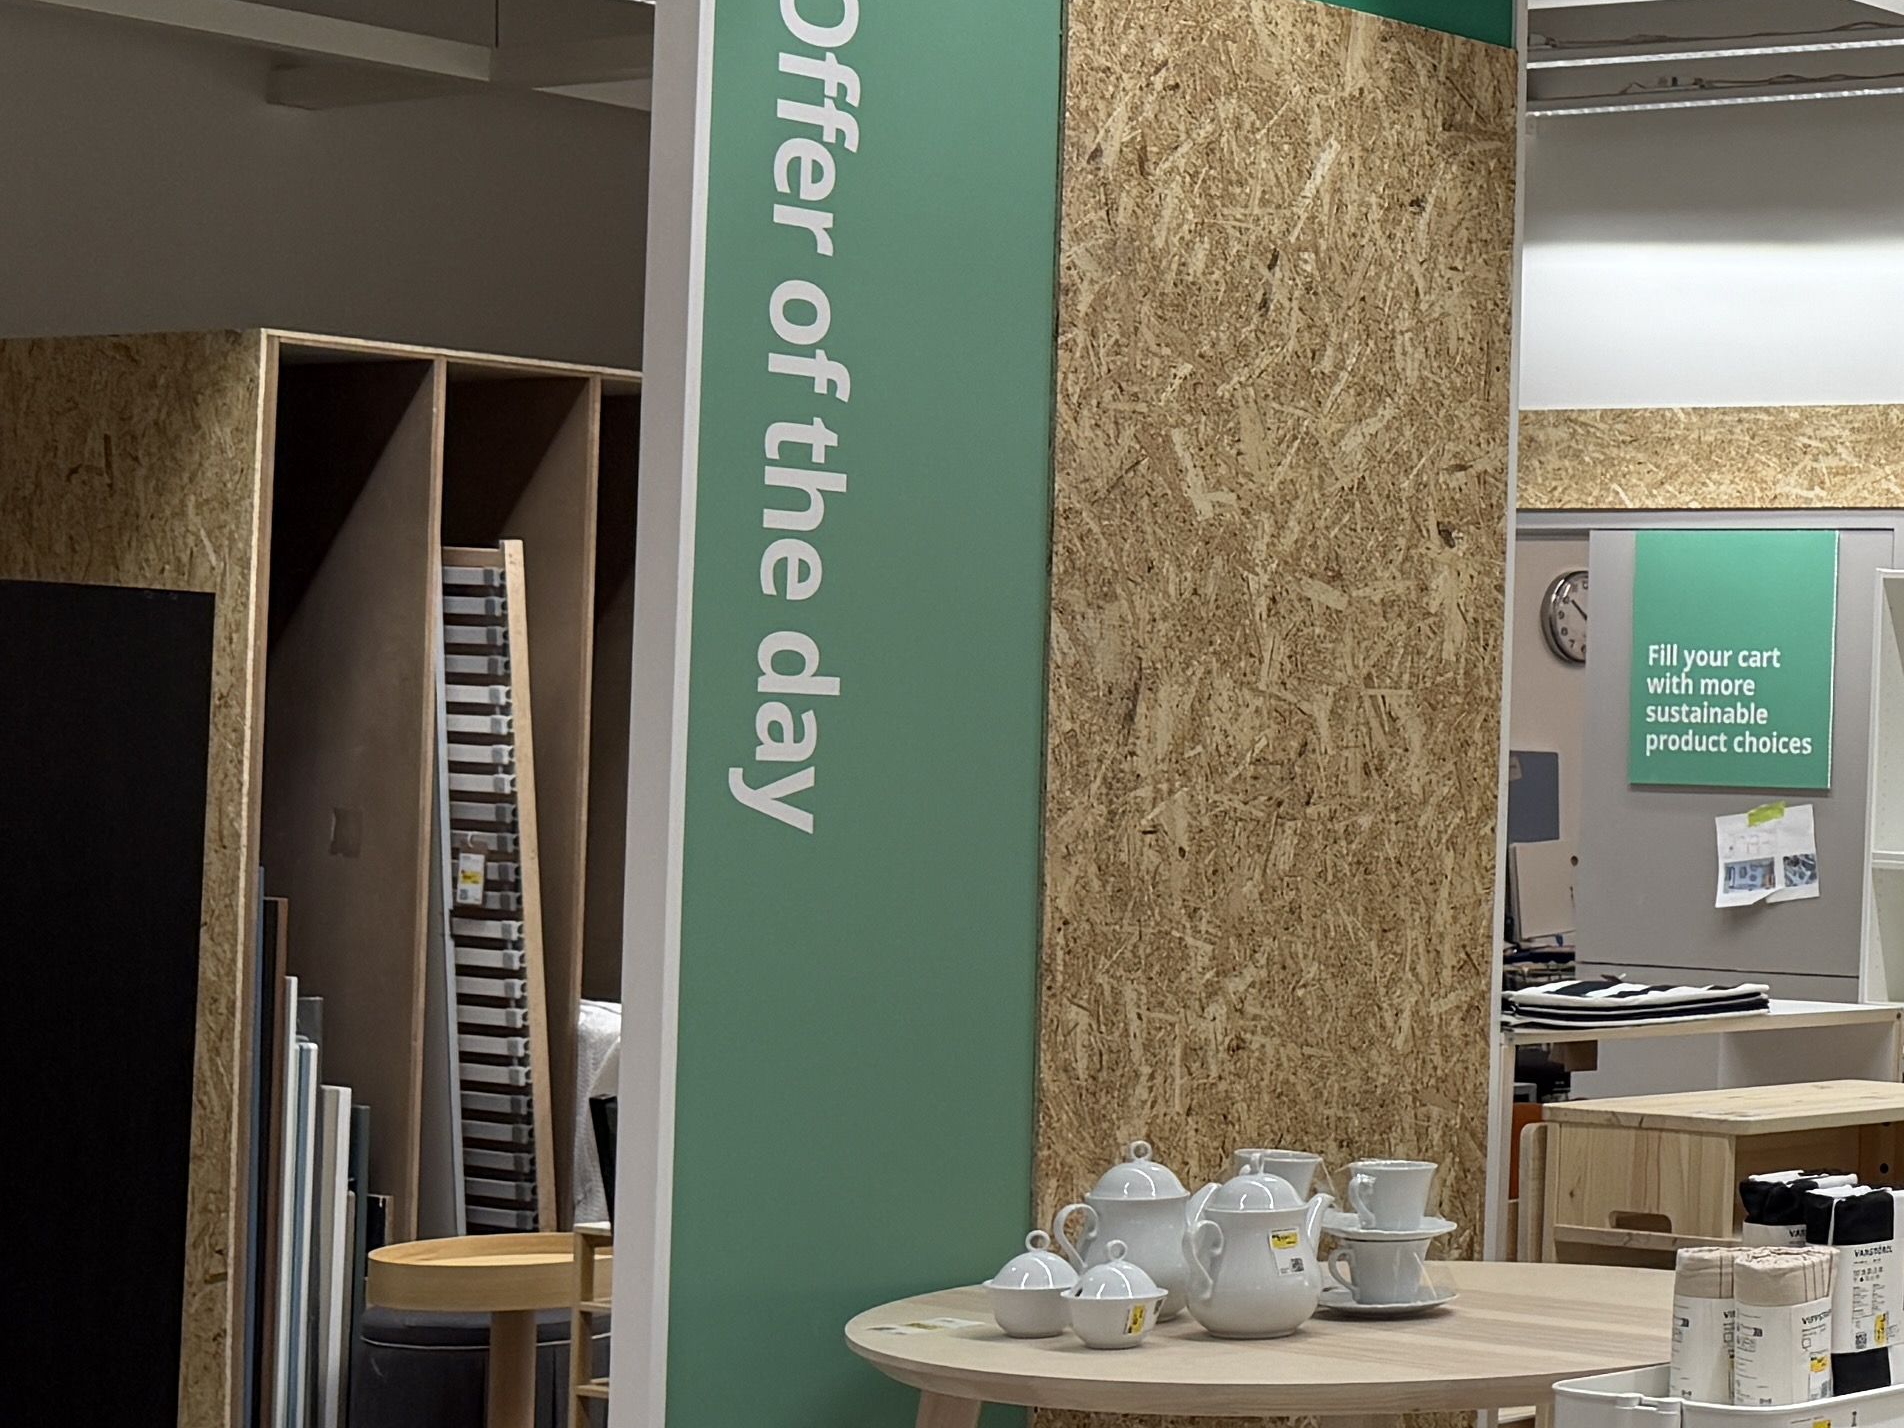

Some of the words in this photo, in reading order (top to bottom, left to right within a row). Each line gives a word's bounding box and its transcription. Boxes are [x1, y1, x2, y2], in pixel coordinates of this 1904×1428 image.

[768, 279, 851, 403] of
[760, 417, 847, 600] the
[1648, 643, 1678, 666] Fill
[1683, 649, 1733, 672] your
[1738, 647, 1781, 668] cart
[1646, 672, 1693, 694] with
[1700, 678, 1755, 696] more
[1646, 702, 1768, 725] sustainable
[728, 631, 841, 834] day
[1646, 729, 1727, 757] product
[1733, 730, 1812, 755] choices
